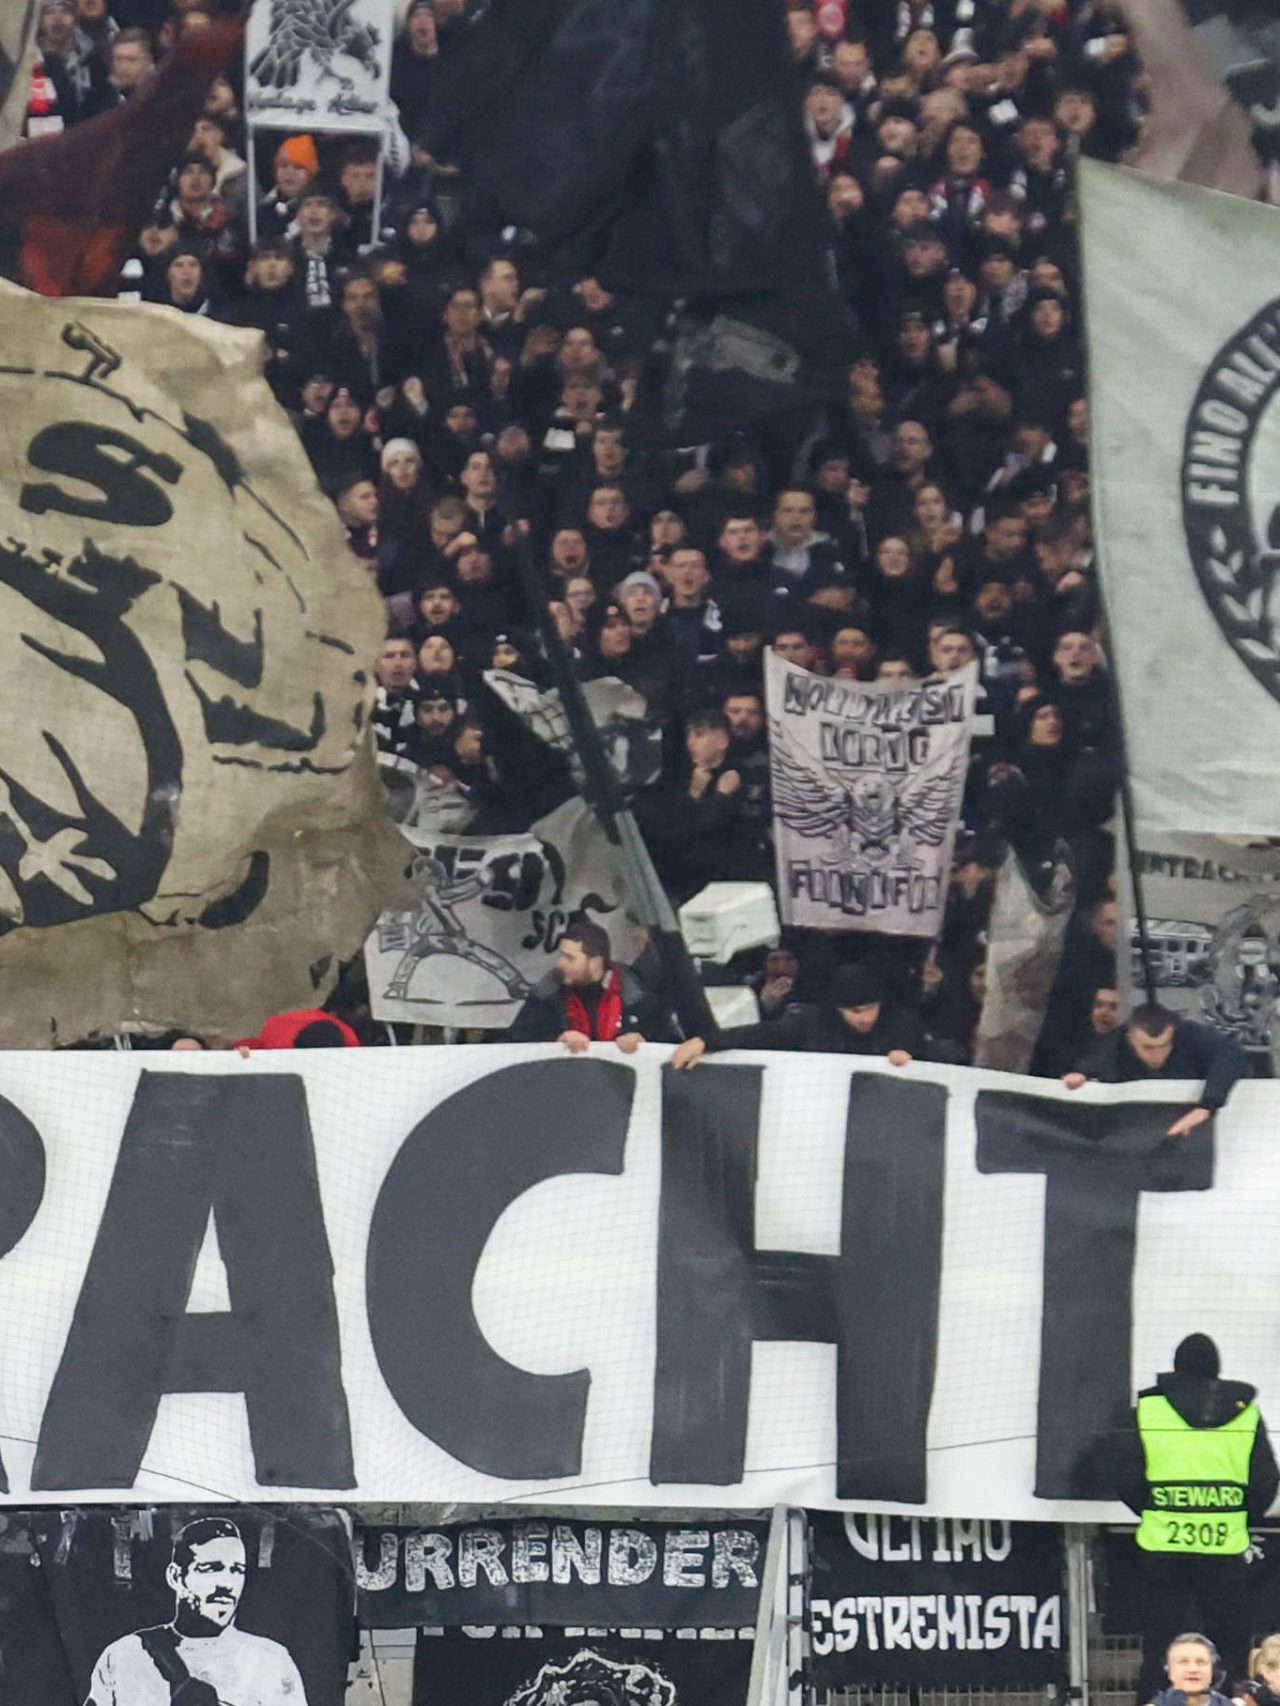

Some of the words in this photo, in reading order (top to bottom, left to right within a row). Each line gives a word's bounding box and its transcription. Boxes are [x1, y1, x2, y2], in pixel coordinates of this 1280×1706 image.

[1186, 398, 1250, 506] FINO
[1151, 1485, 1245, 1508] STEWARD
[843, 1513, 1013, 1563] ULTIMO
[811, 1594, 1062, 1656] ESTREMISTA
